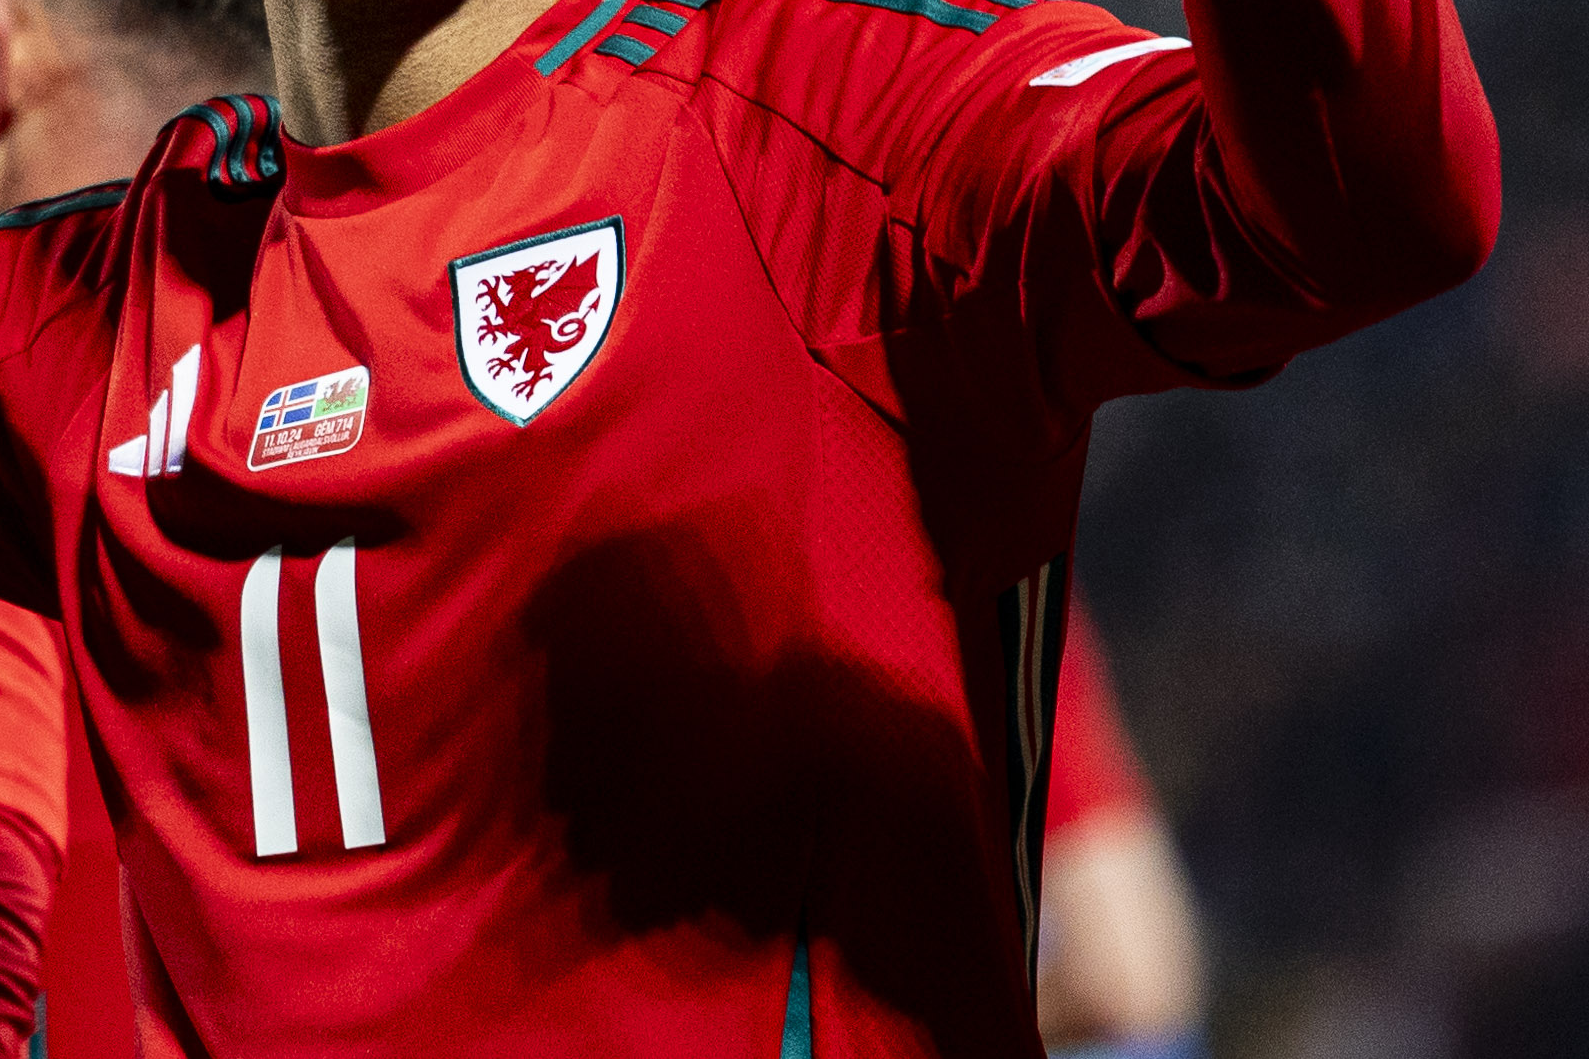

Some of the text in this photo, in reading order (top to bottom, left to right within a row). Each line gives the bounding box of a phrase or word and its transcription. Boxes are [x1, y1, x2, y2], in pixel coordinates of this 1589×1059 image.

[265, 428, 303, 447] 11.10.24
[336, 416, 354, 431] 714
[240, 535, 386, 857] 11
